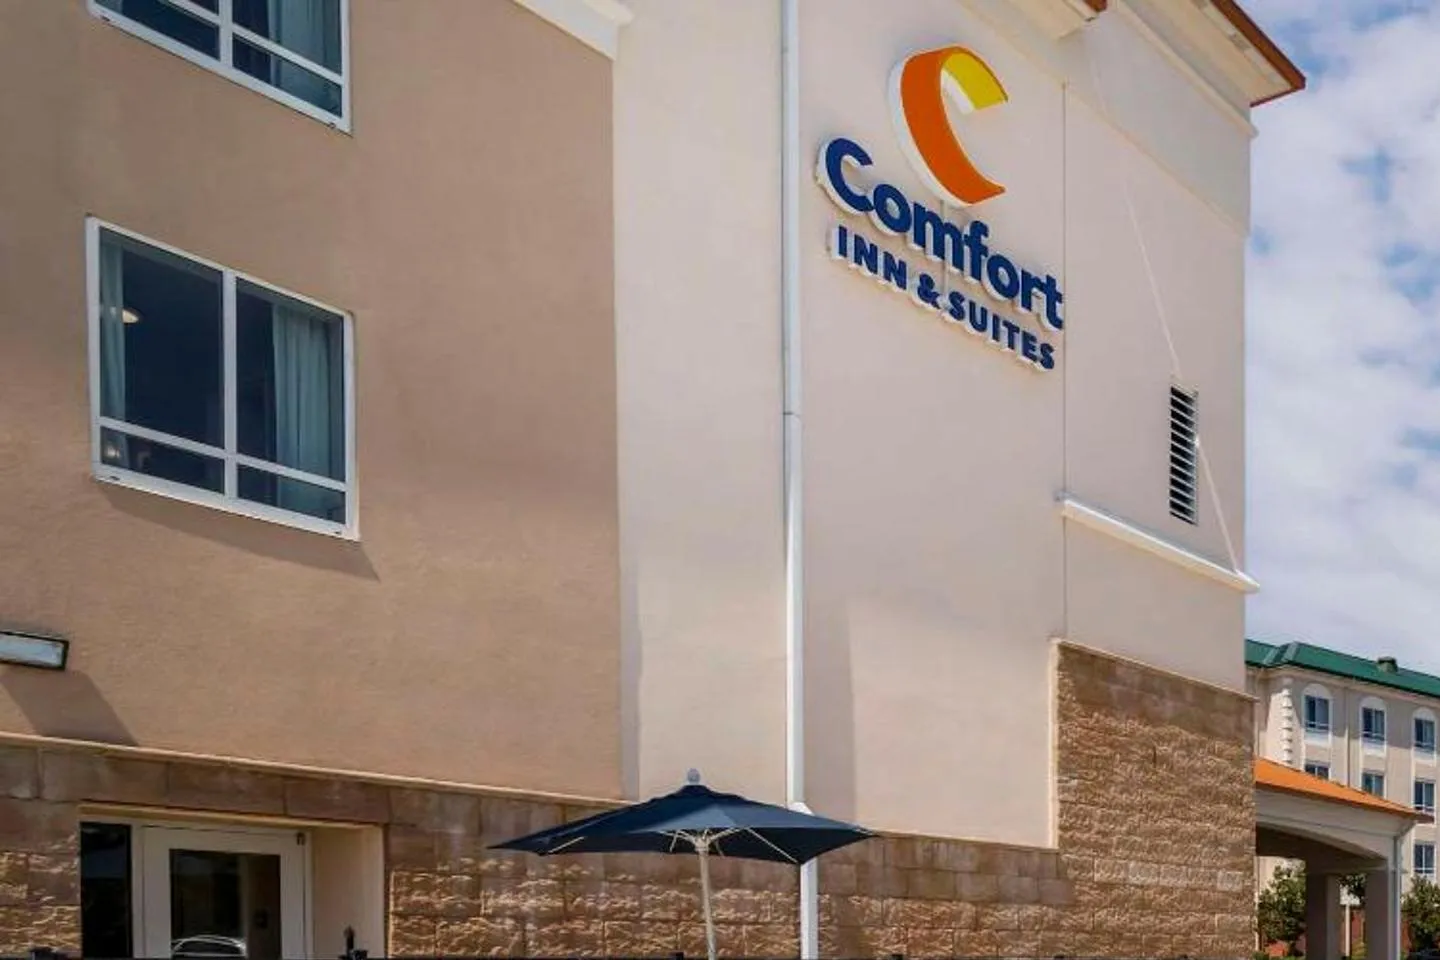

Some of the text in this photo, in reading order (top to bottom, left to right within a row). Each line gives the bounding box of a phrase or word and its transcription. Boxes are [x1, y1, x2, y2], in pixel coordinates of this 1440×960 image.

[825, 137, 1063, 331] Comfort
[838, 225, 1055, 370] INN & SUITES
